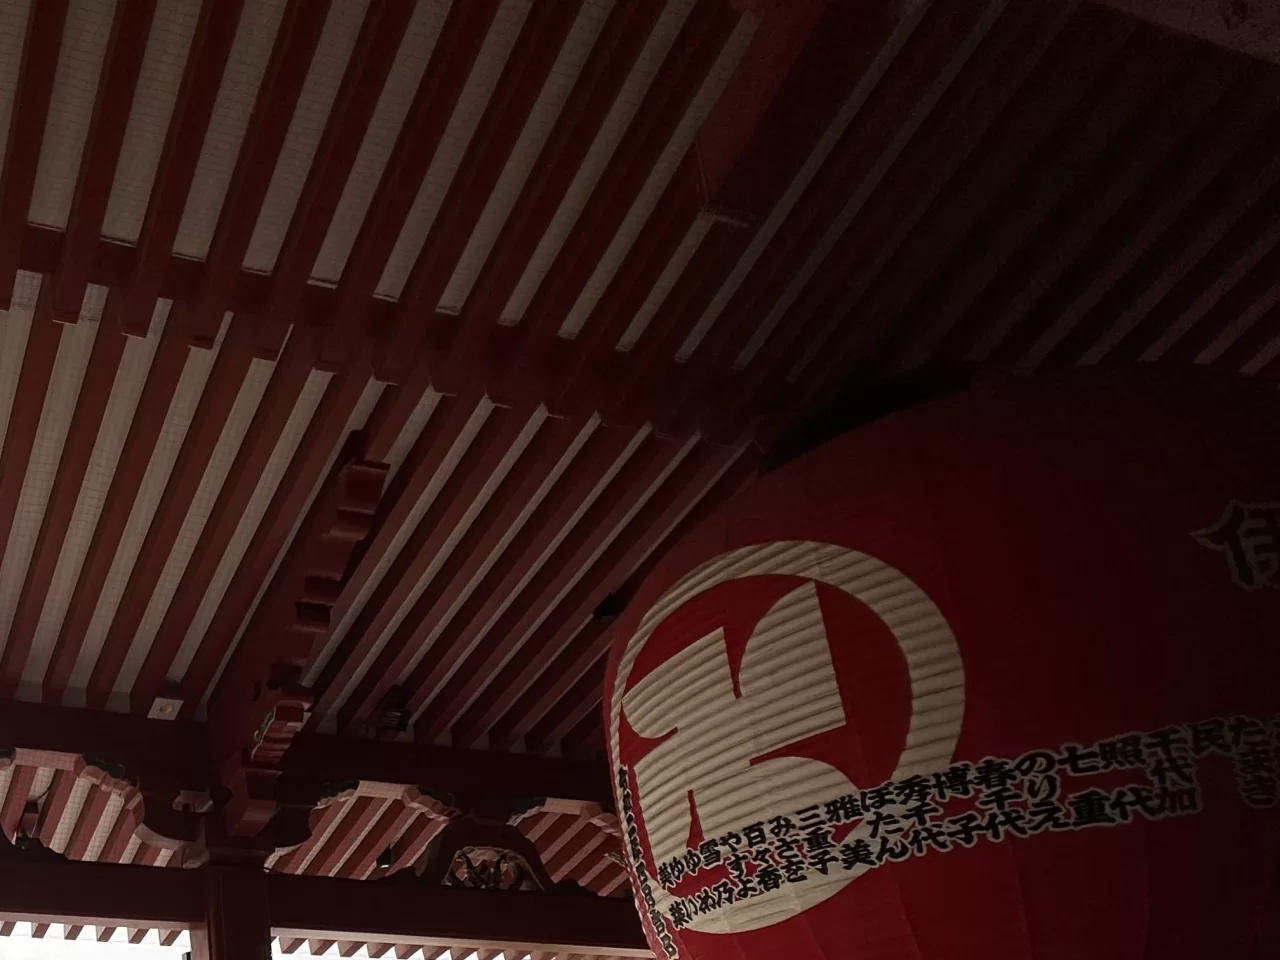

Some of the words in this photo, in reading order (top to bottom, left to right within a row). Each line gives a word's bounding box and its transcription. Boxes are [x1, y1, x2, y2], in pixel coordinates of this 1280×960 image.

[936, 767, 981, 843] 博子
[977, 759, 1033, 838] 春千代
[1016, 752, 1070, 830] のりえ
[1060, 747, 1116, 827] 七重
[1098, 736, 1157, 820] 照代
[1142, 732, 1197, 814] 千代加
[769, 816, 807, 882] みさを
[796, 805, 837, 875] 三重子
[826, 795, 877, 870] 雅美
[862, 782, 907, 862] ぼたん
[898, 776, 948, 851] 秀千代
[669, 857, 698, 921] ゆい
[684, 849, 717, 914] ゆめ
[700, 840, 735, 906] 雪乃
[721, 831, 757, 900] やすよ
[743, 823, 781, 891] 百々香
[657, 862, 689, 928] 美葉
